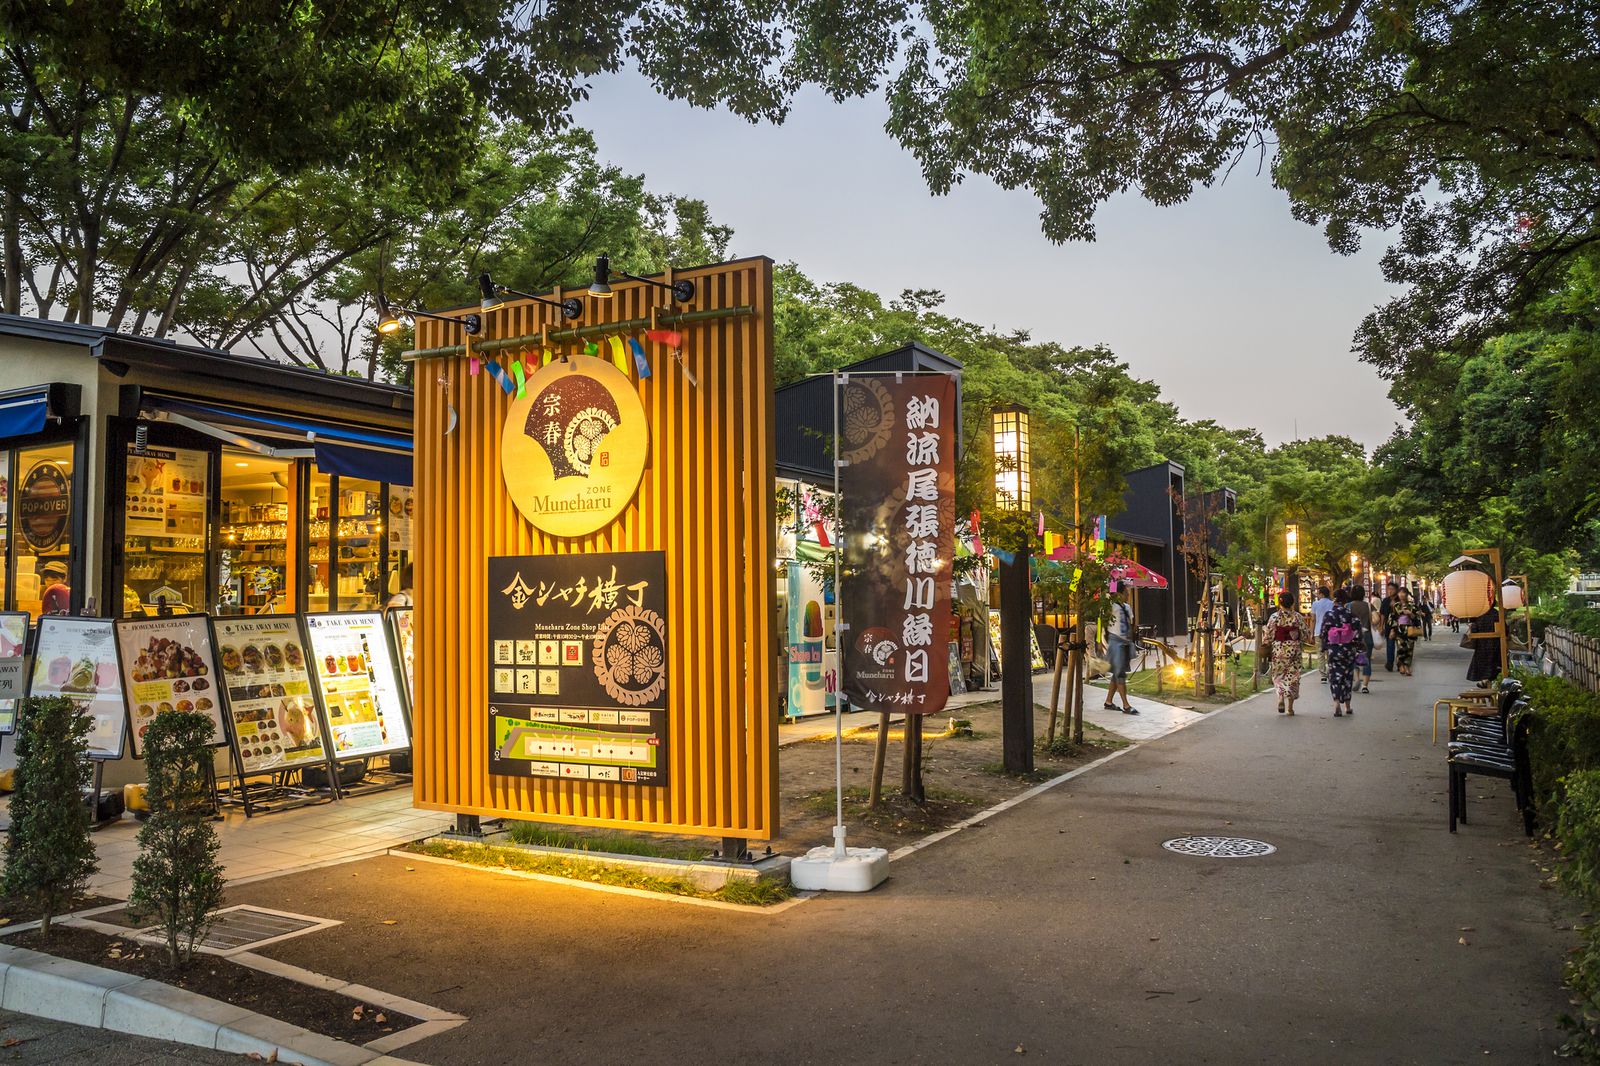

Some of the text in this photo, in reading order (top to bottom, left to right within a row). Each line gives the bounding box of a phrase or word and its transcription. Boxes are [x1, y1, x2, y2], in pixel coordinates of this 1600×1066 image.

[543, 393, 561, 445] 宗春
[586, 485, 612, 495] ZONE
[533, 494, 612, 512] Muneharu
[902, 394, 940, 683] 納涼尾張徳川縁日
[501, 564, 649, 615] 金シャチ横丁
[132, 623, 167, 631] HOMEMADE
[235, 622, 292, 632] TAKE AWAY MENU
[326, 619, 342, 627] TAKE
[565, 623, 581, 631] Zone
[582, 623, 597, 633] Shop
[0, 679, 12, 690] 列
[522, 674, 530, 690] つだ
